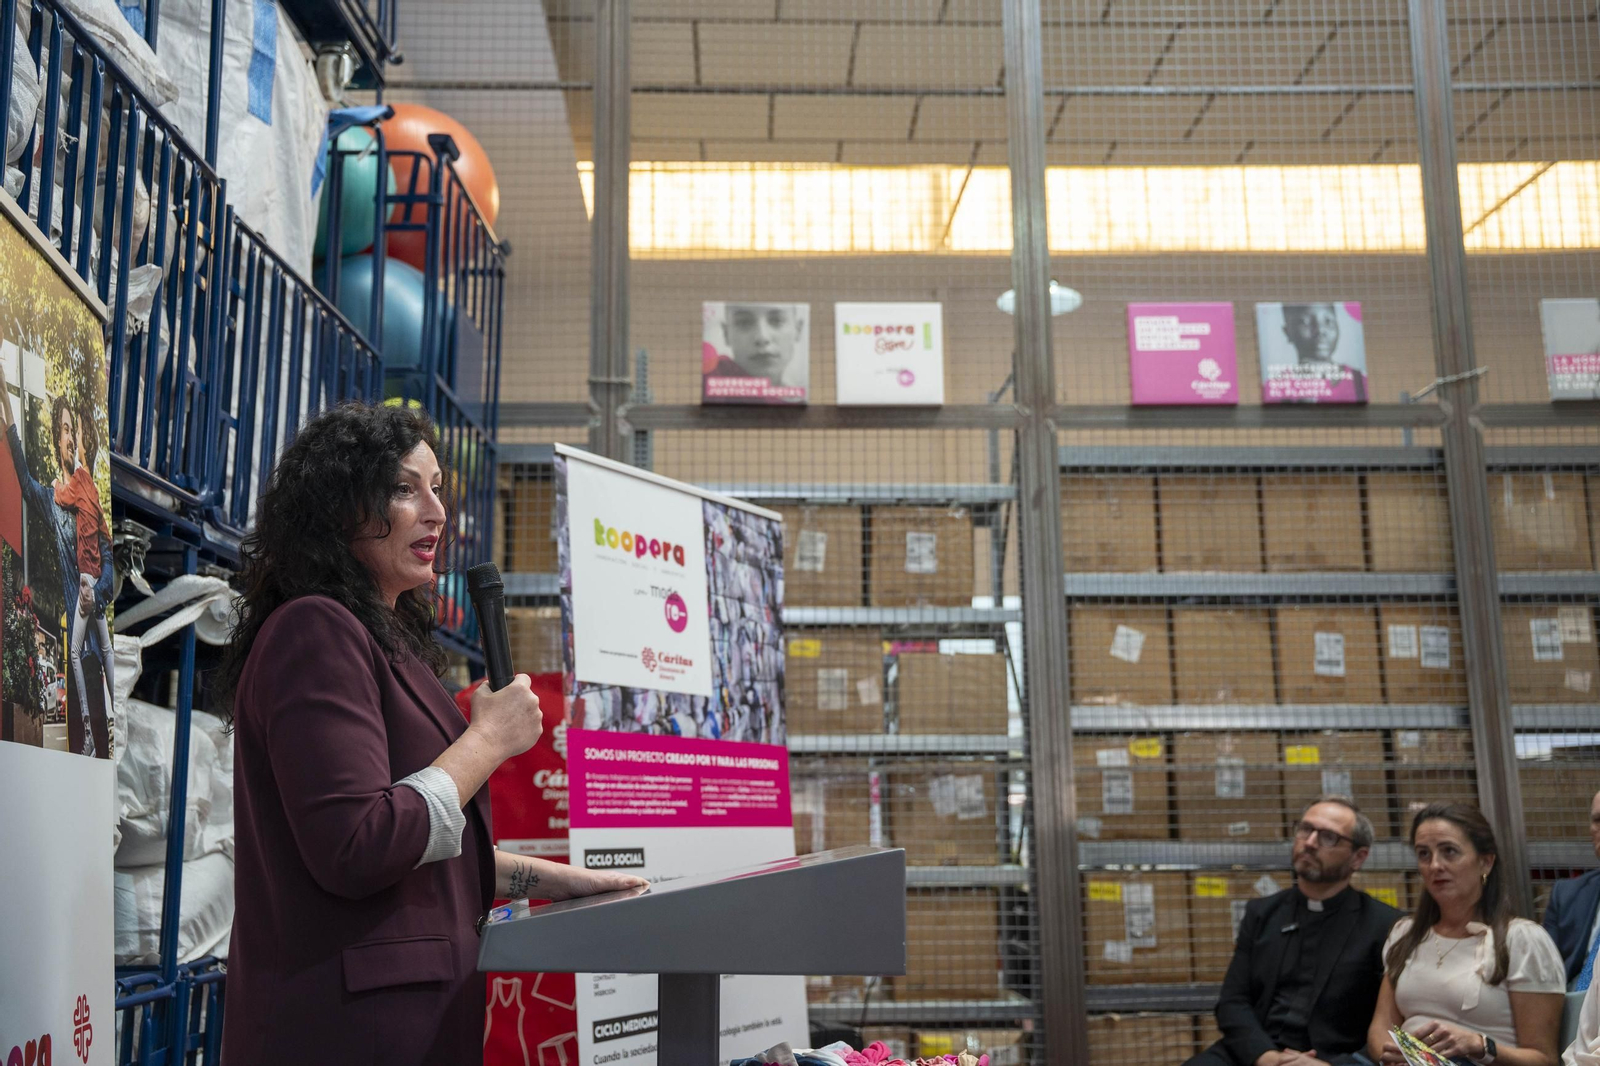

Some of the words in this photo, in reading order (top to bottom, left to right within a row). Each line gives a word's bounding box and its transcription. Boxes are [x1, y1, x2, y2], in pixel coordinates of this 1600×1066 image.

[594, 518, 686, 567] koopera
[584, 747, 614, 761] SOMOS
[615, 748, 627, 761] UN
[627, 749, 664, 763] PROYECTO
[665, 752, 695, 765] CREADO
[696, 754, 711, 766] POR
[711, 755, 717, 766] Y
[717, 755, 735, 767] PARA
[735, 757, 748, 768] LAS
[586, 854, 613, 867] CICLO
[613, 852, 643, 865] SOCIAL
[594, 1022, 621, 1038] CICLO
[593, 1050, 621, 1065] Cuando
[622, 1048, 629, 1059] la
